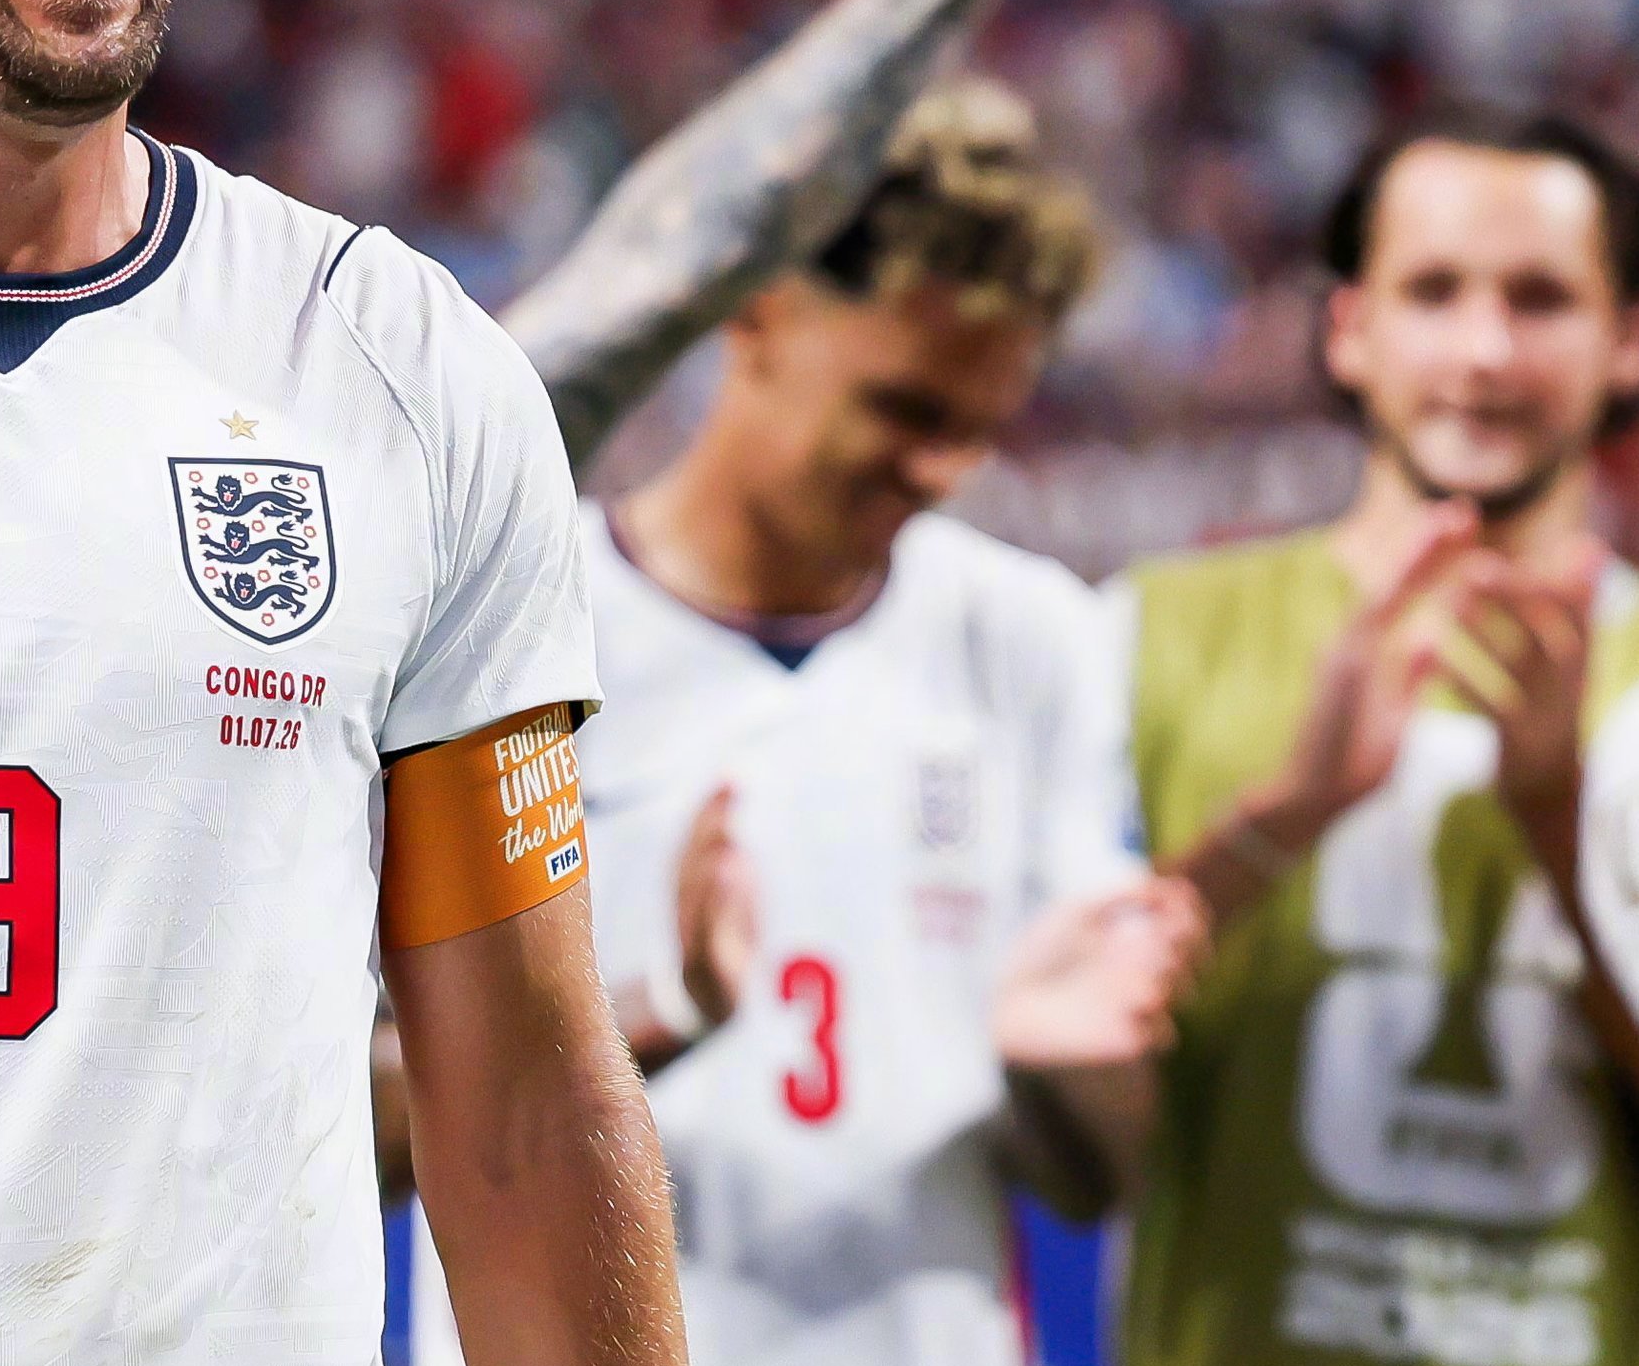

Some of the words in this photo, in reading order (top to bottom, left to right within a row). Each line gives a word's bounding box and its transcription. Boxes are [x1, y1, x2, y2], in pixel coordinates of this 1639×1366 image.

[206, 665, 295, 701] CONGO
[300, 673, 326, 707] DR
[220, 715, 301, 749] 01.07.26
[499, 734, 580, 817] UNITES
[498, 817, 546, 864] the
[550, 845, 580, 875] FIFA
[780, 955, 840, 1125] 3
